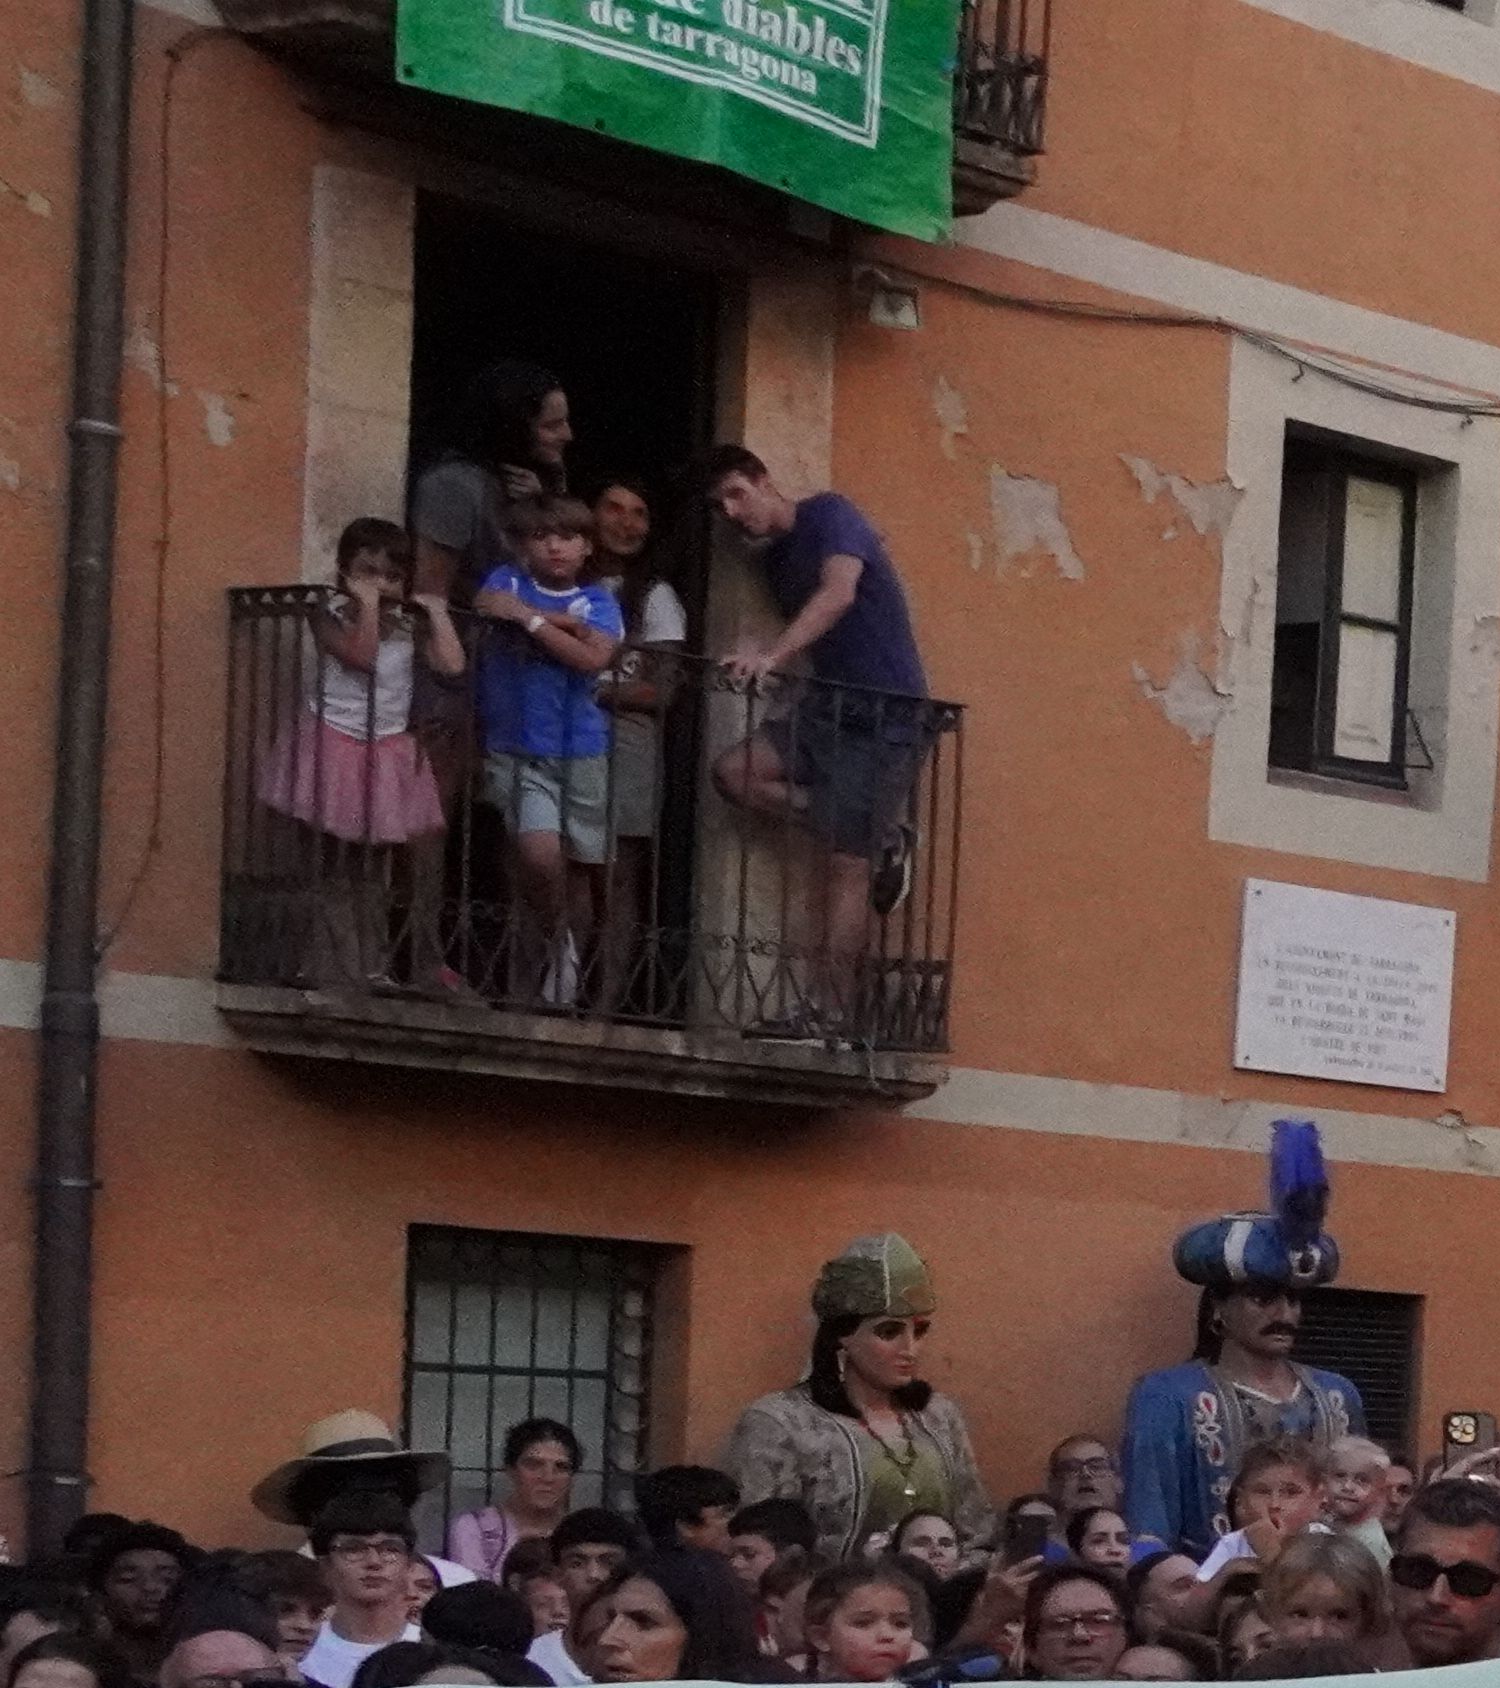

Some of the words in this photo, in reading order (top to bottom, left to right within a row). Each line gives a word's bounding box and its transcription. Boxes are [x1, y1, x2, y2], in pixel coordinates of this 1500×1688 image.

[589, 0, 637, 34] de
[648, 10, 817, 96] tarragona
[722, 0, 863, 76] diables
